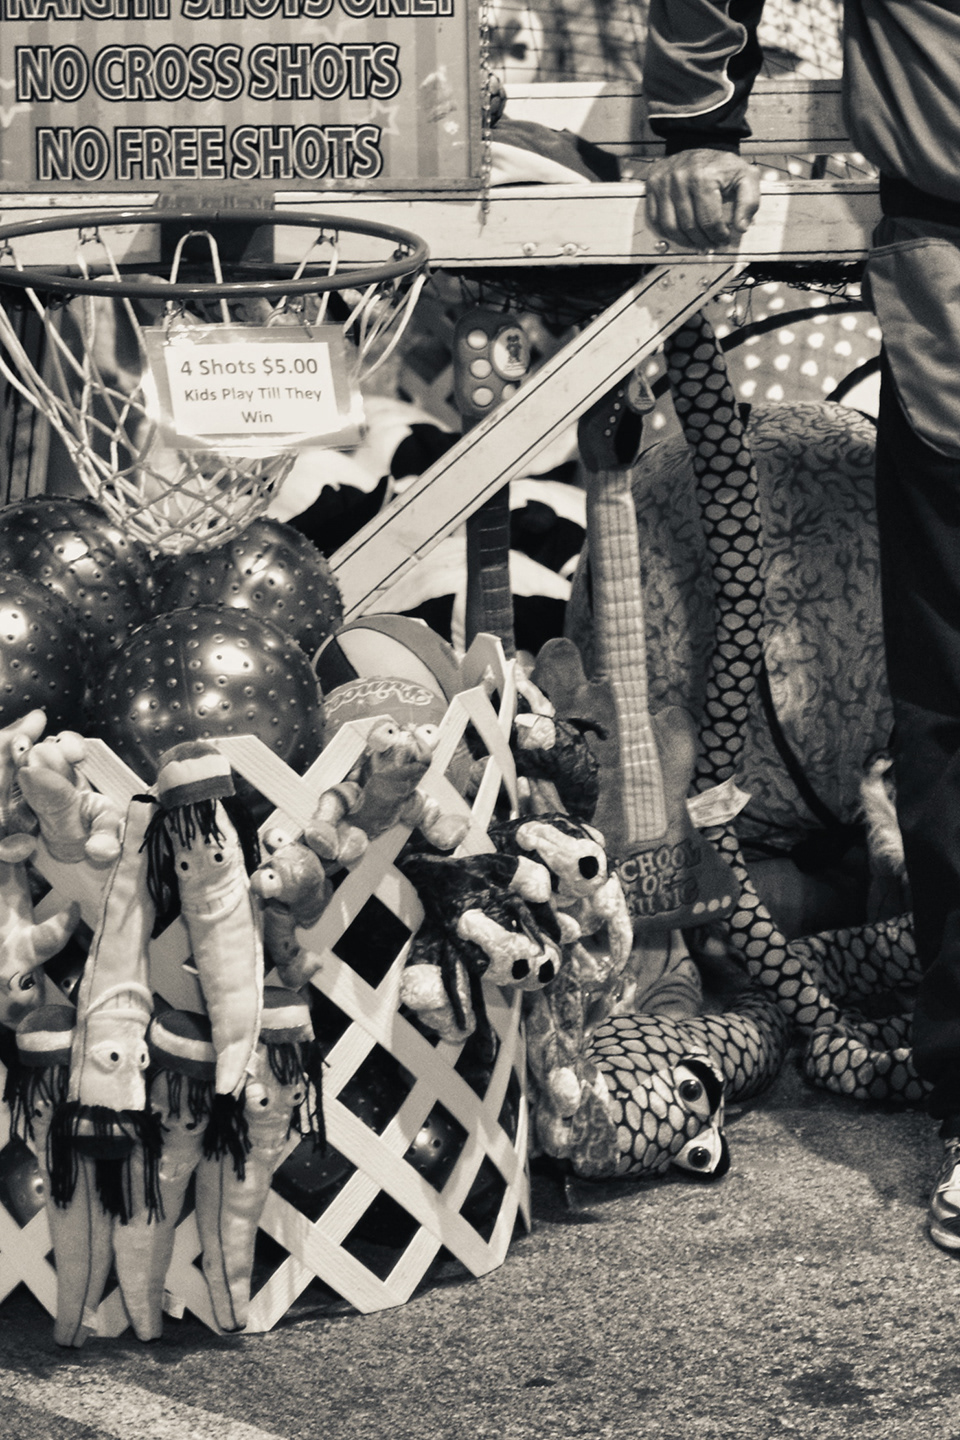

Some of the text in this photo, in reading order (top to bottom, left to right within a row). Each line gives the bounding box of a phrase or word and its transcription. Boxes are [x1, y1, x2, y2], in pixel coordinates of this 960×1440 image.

[15, 43, 401, 102] NO CROSS SHOTS
[36, 124, 384, 181] NO FREE SHOTS
[180, 357, 317, 377] 4 Shots $5.00
[184, 386, 322, 403] Kids Play Till They
[240, 411, 273, 424] Win
